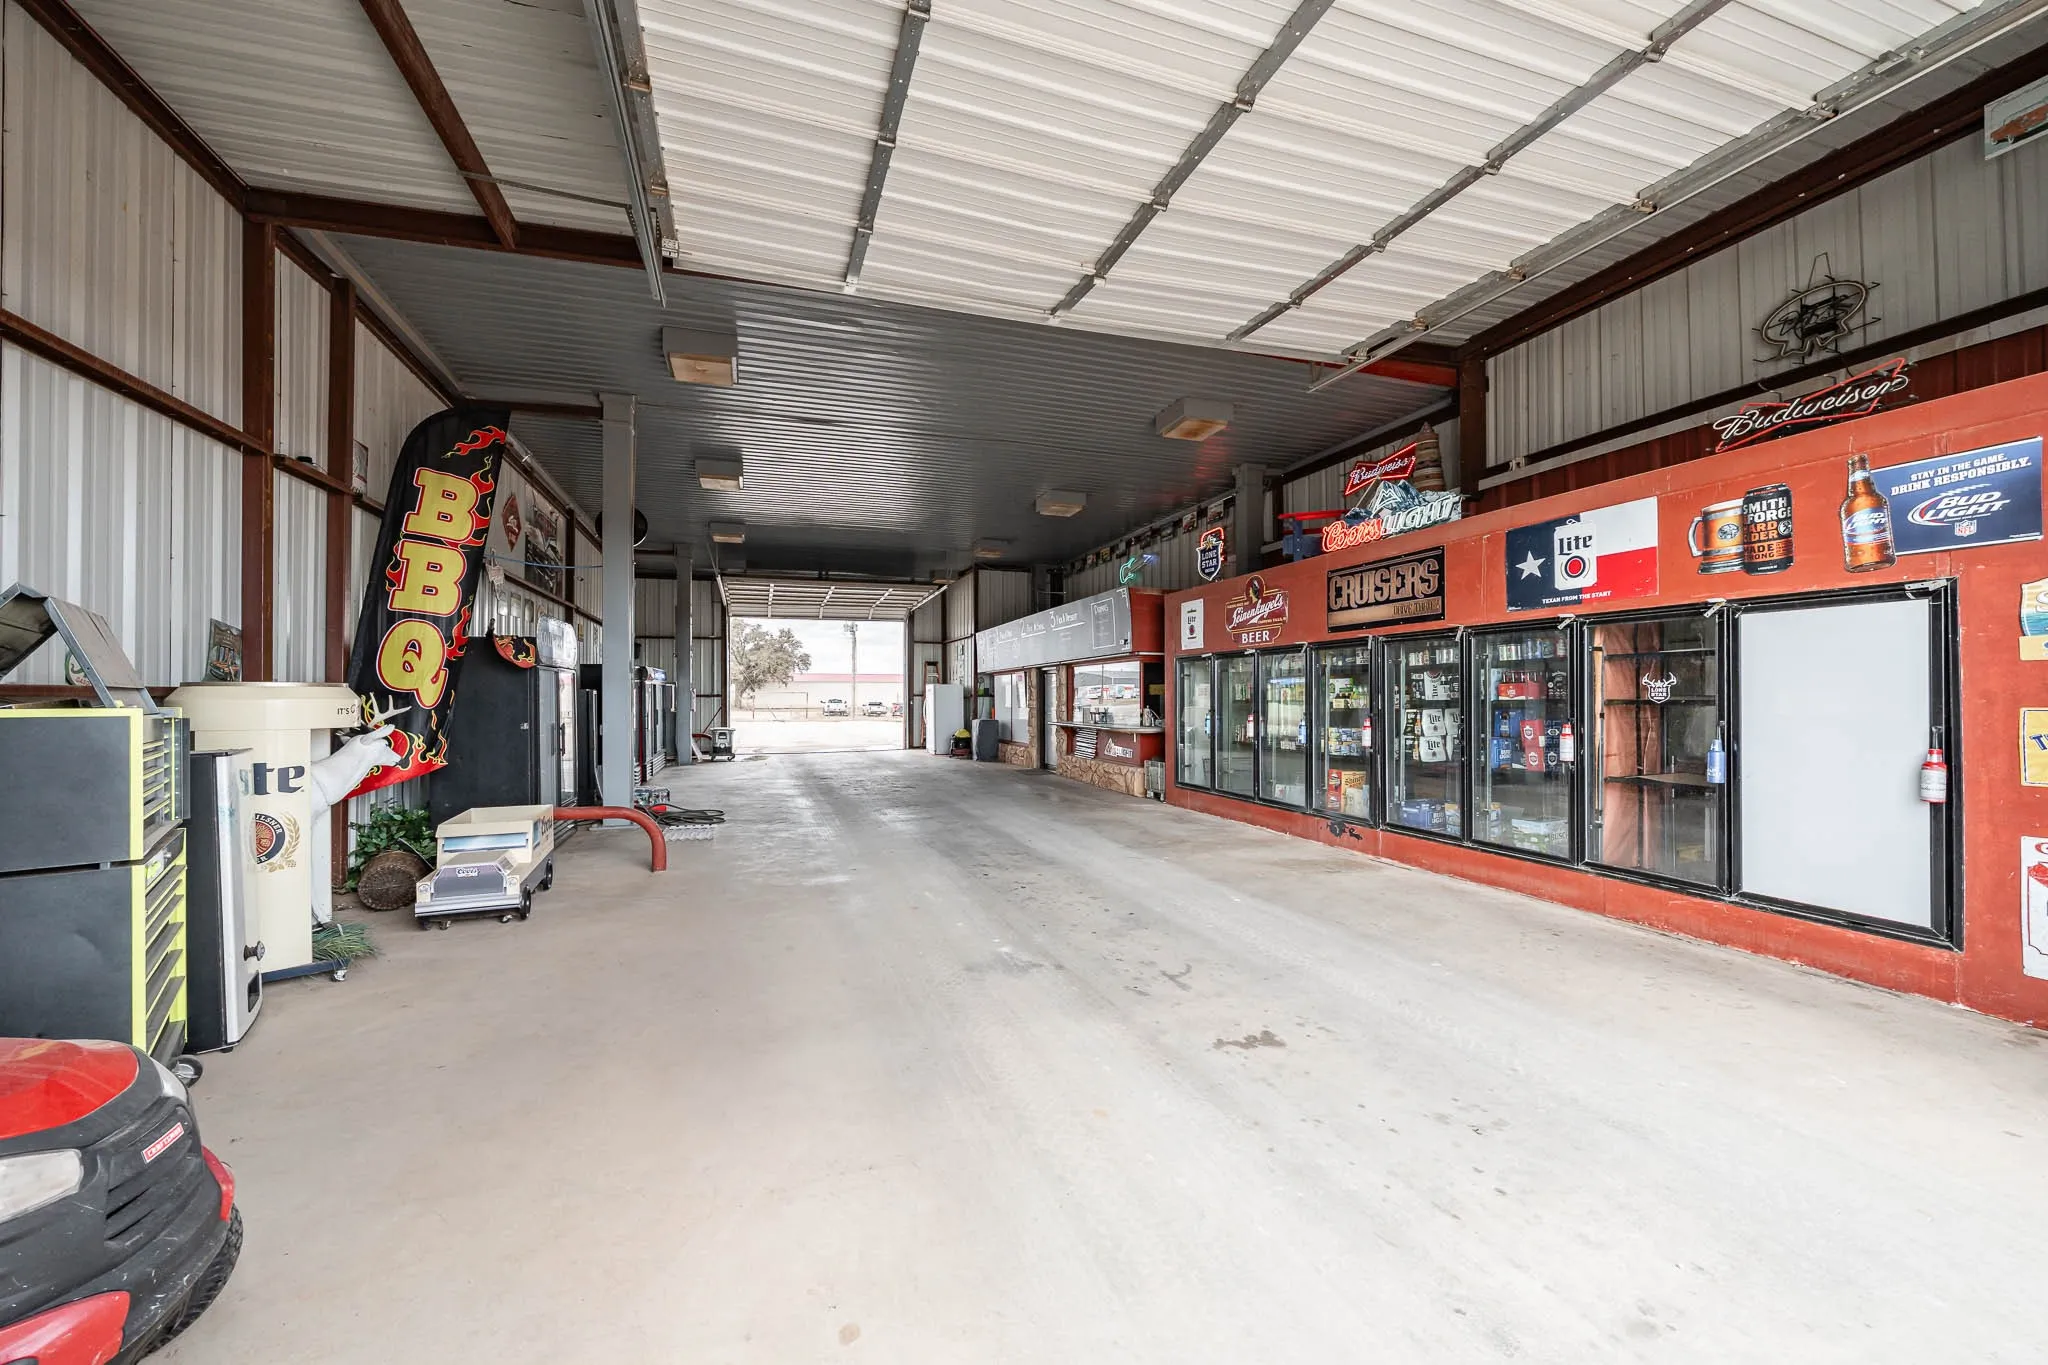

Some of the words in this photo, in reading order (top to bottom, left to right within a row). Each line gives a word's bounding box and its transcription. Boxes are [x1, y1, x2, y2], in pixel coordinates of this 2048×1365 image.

[1713, 375, 1909, 439] Budweiser
[1891, 480, 1931, 497] DRINK
[1934, 456, 2032, 487] RESPONSIBLY.
[1910, 470, 1935, 482] STAY
[1936, 466, 1951, 475] IN
[1951, 461, 1972, 473] THE
[1973, 453, 2008, 469] GAME.
[1743, 496, 1787, 515] SMITH
[1935, 491, 2002, 510] BUD
[1747, 506, 1792, 525] FORGE
[1920, 499, 2012, 522] LIGHT
[1322, 518, 1383, 552] Coors
[1380, 495, 1462, 536] LIGHT
[1956, 524, 1974, 535] NFL
[1558, 533, 1593, 556] Lite
[1202, 550, 1217, 560] LONE
[1202, 559, 1217, 569] STAR
[377, 467, 480, 710] BBQ
[1329, 558, 1440, 611] CRUISERS
[1591, 590, 1613, 598] START
[1228, 594, 1284, 629] Leinenkugel's
[1242, 630, 1270, 644] BEER
[1430, 714, 1441, 724] Lite
[1426, 740, 1441, 751] Lite
[255, 814, 283, 834] ILSNER
[457, 868, 479, 876] Coors
